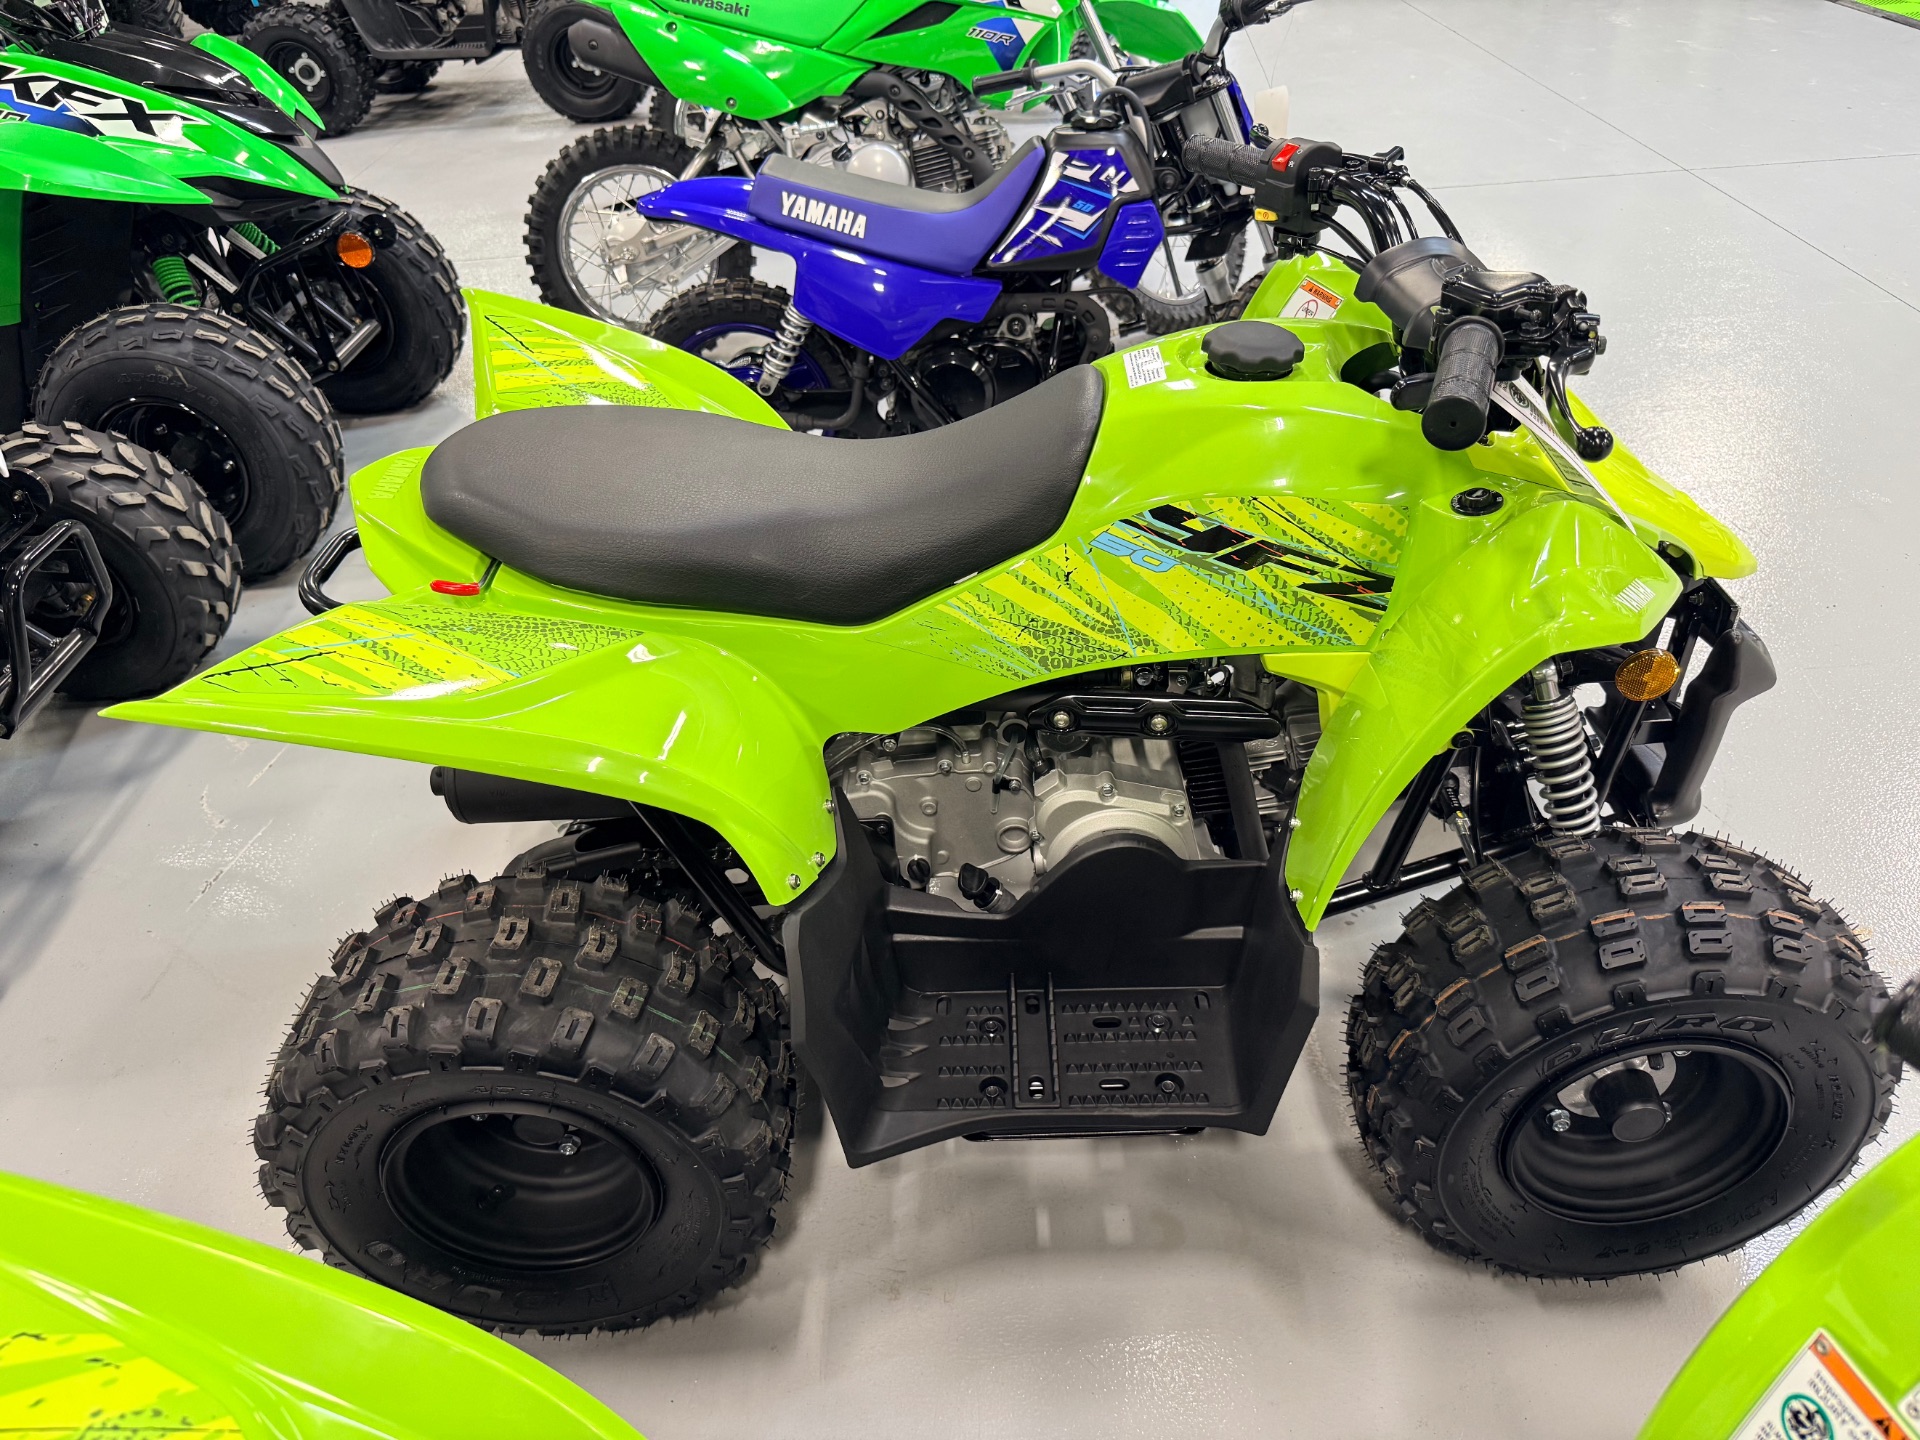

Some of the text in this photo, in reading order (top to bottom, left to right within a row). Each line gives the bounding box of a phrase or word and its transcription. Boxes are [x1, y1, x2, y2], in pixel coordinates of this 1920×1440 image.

[966, 27, 1017, 46] 110R
[781, 190, 867, 239] YAMAHA
[1072, 200, 1096, 213] 50
[1313, 288, 1333, 304] WARNING
[1088, 530, 1181, 573] 50
[1542, 1012, 1775, 1077] DURO
